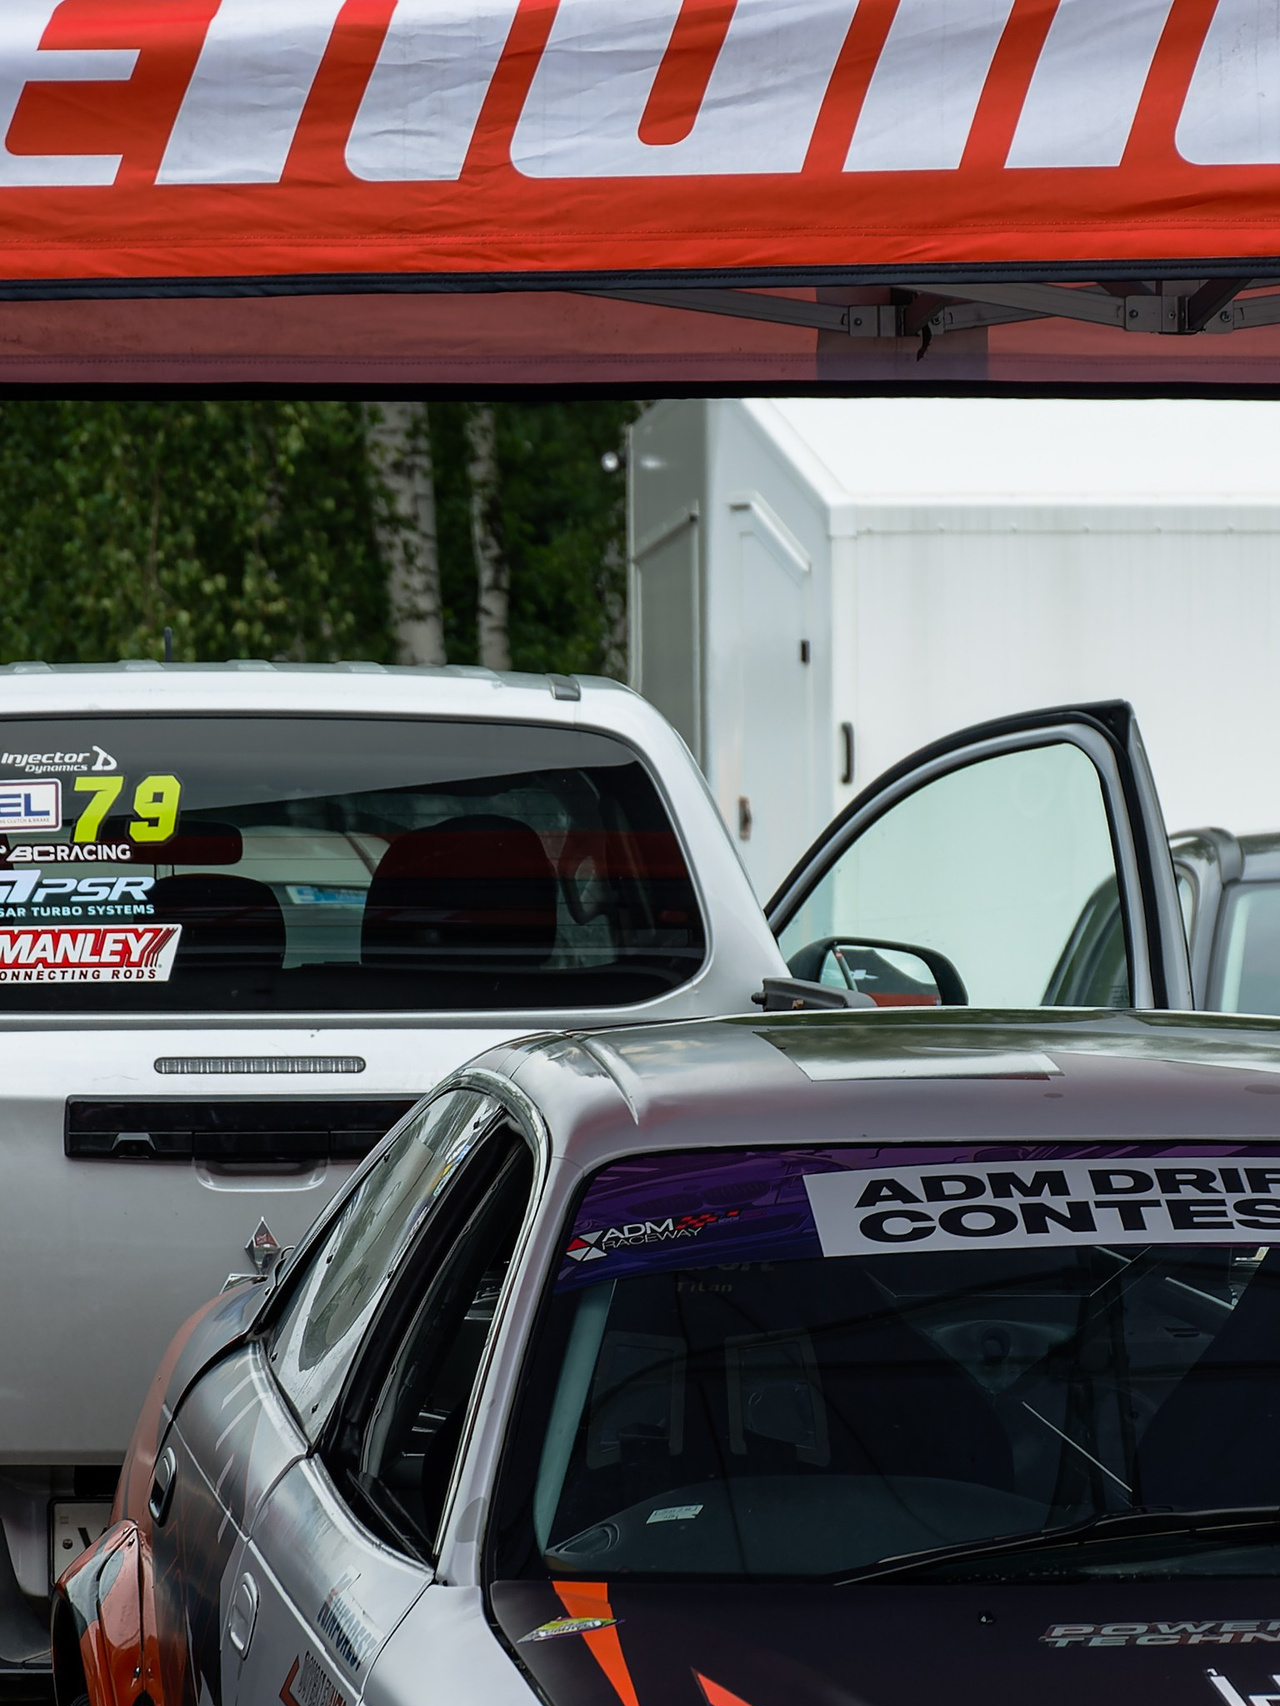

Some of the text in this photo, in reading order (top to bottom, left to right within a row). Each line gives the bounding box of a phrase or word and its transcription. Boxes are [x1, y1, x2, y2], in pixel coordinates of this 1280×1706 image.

[1, 751, 90, 766] Injector
[25, 764, 88, 774] Dynamics
[74, 775, 181, 842] 79
[31, 907, 82, 917] TURBO
[88, 905, 154, 915] SYSTEMS
[0, 932, 154, 964] MANLEY
[112, 969, 157, 979] RODS
[855, 1170, 1072, 1209] ADM
[602, 1218, 674, 1242] ADM
[602, 1227, 702, 1251] RACEWAY
